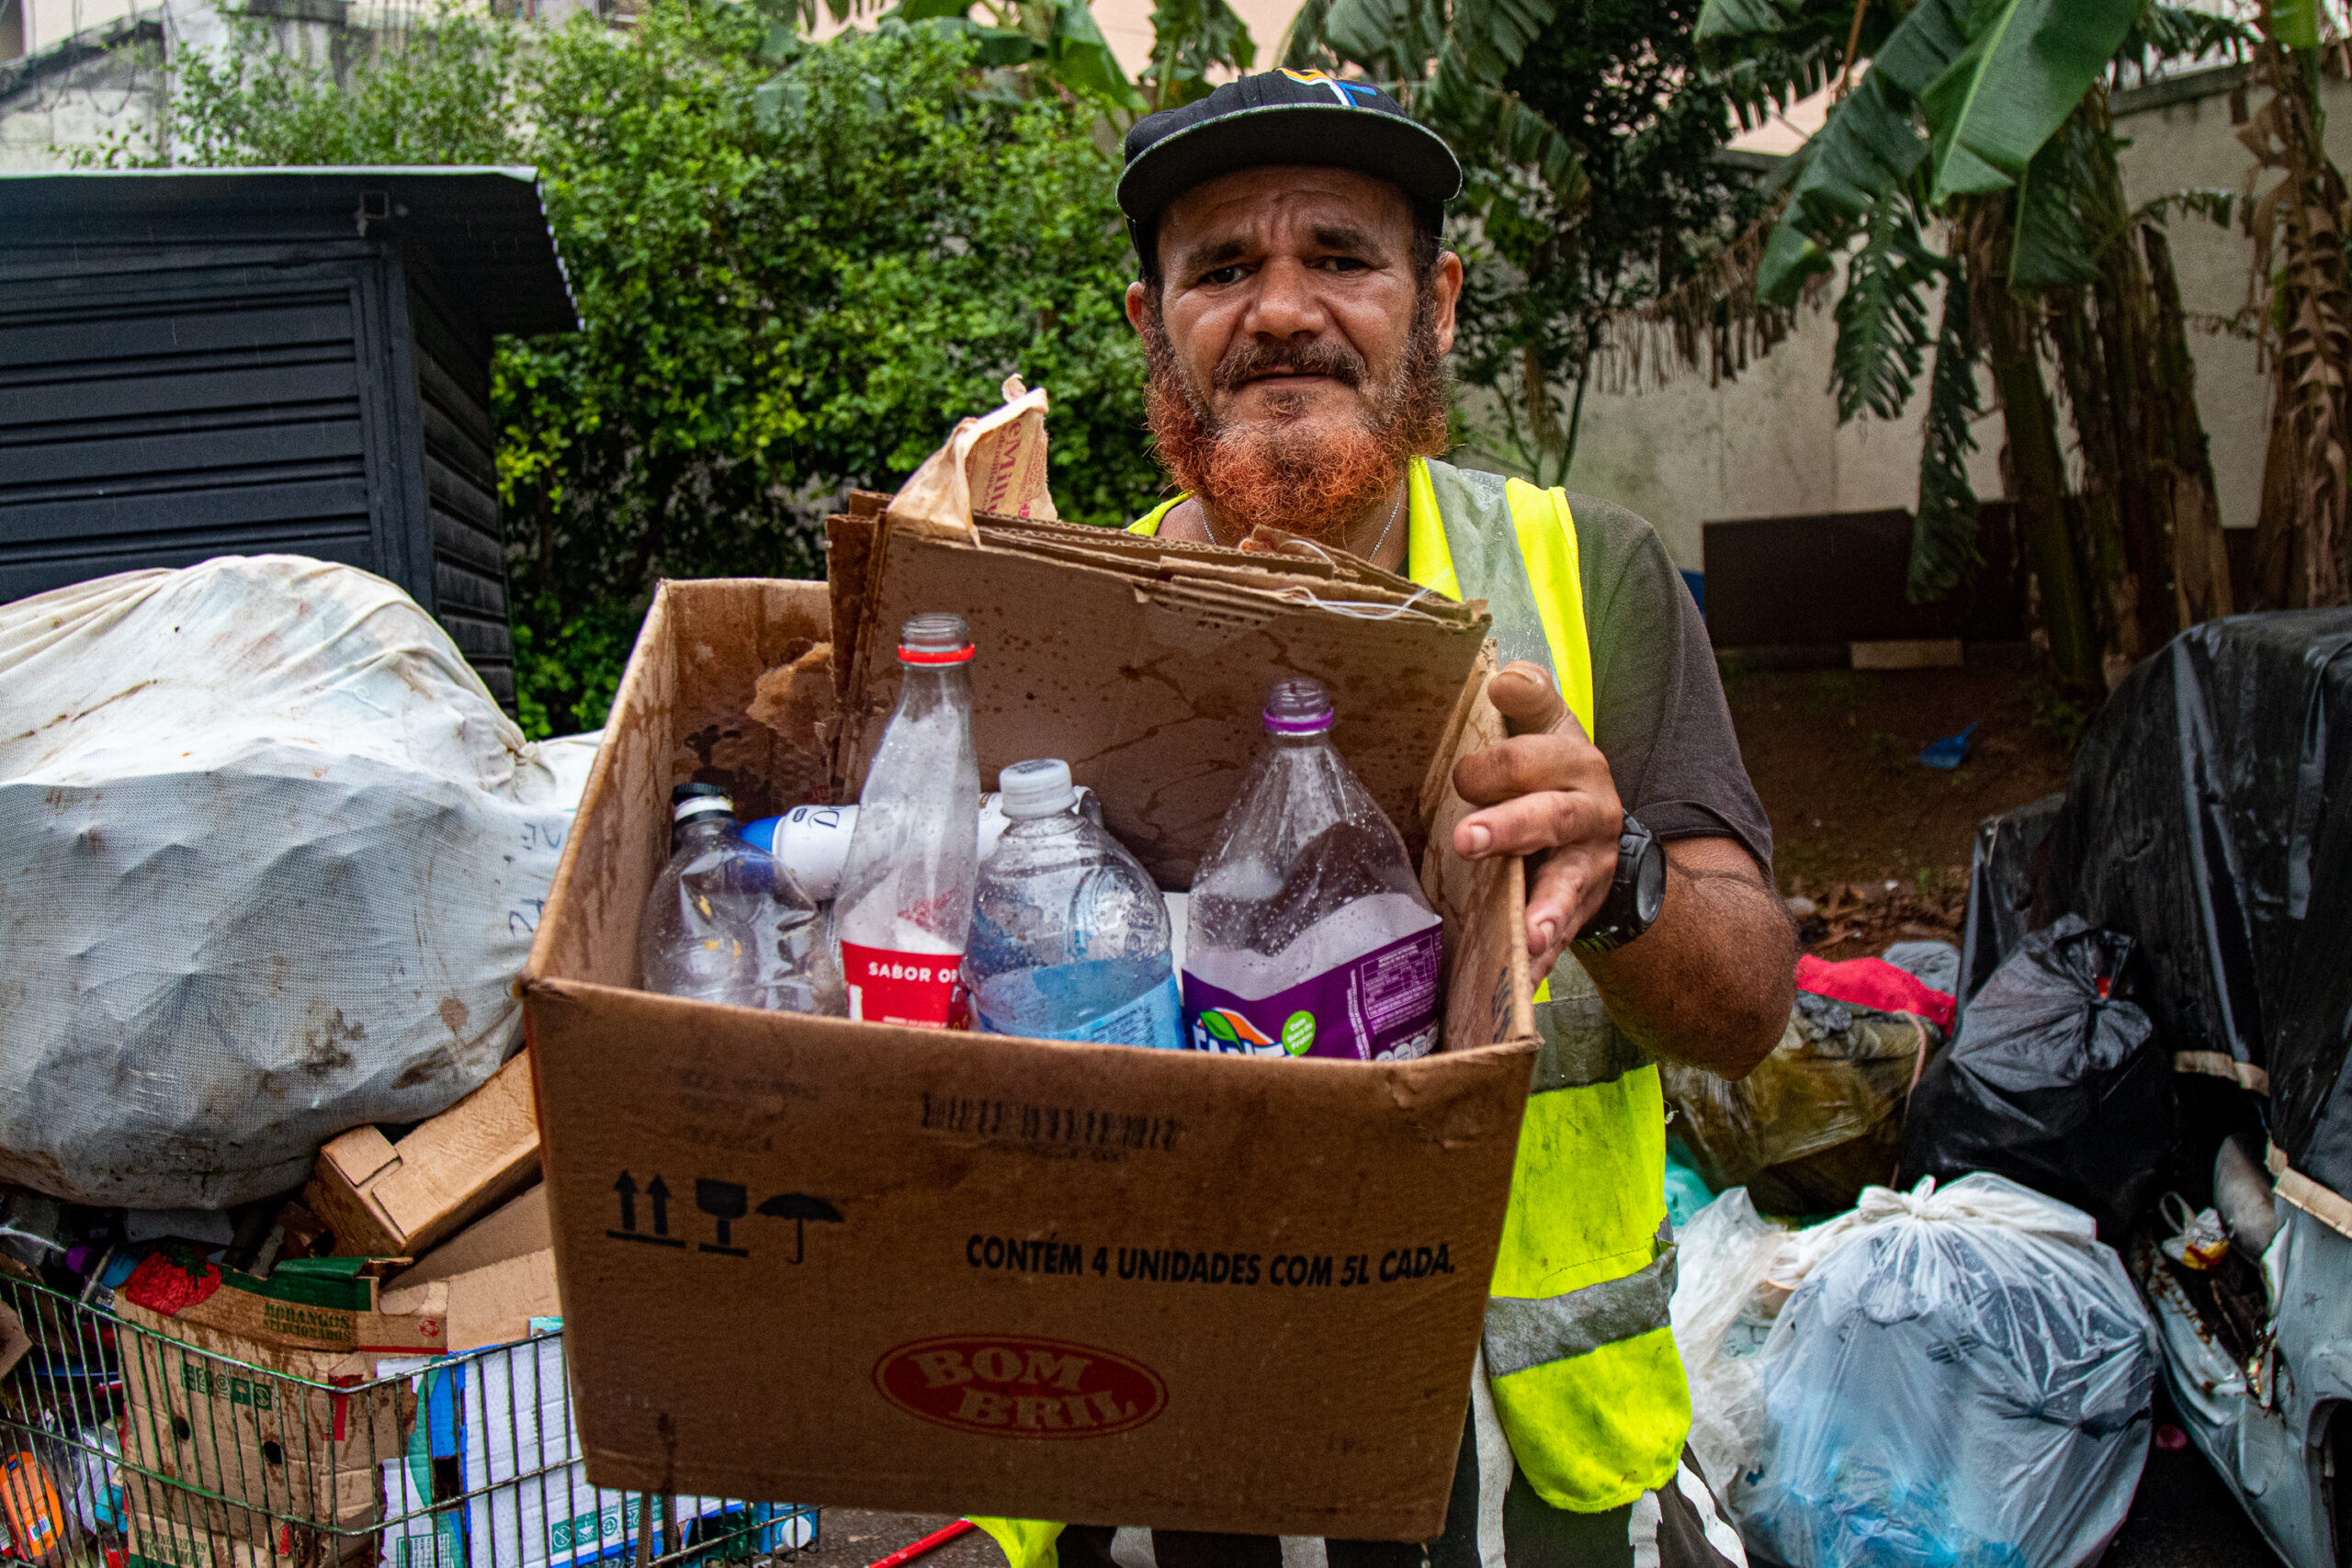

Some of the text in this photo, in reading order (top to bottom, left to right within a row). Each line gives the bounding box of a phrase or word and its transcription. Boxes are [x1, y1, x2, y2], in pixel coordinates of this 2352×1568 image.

[867, 961, 932, 983] SABOR
[967, 1232, 1456, 1287] CONTÉM 4 UNIDADES COM 5L CADA.
[264, 1301, 350, 1329] MORANGOS
[909, 1347, 1094, 1392] BOM
[949, 1386, 1138, 1428] BRIL
